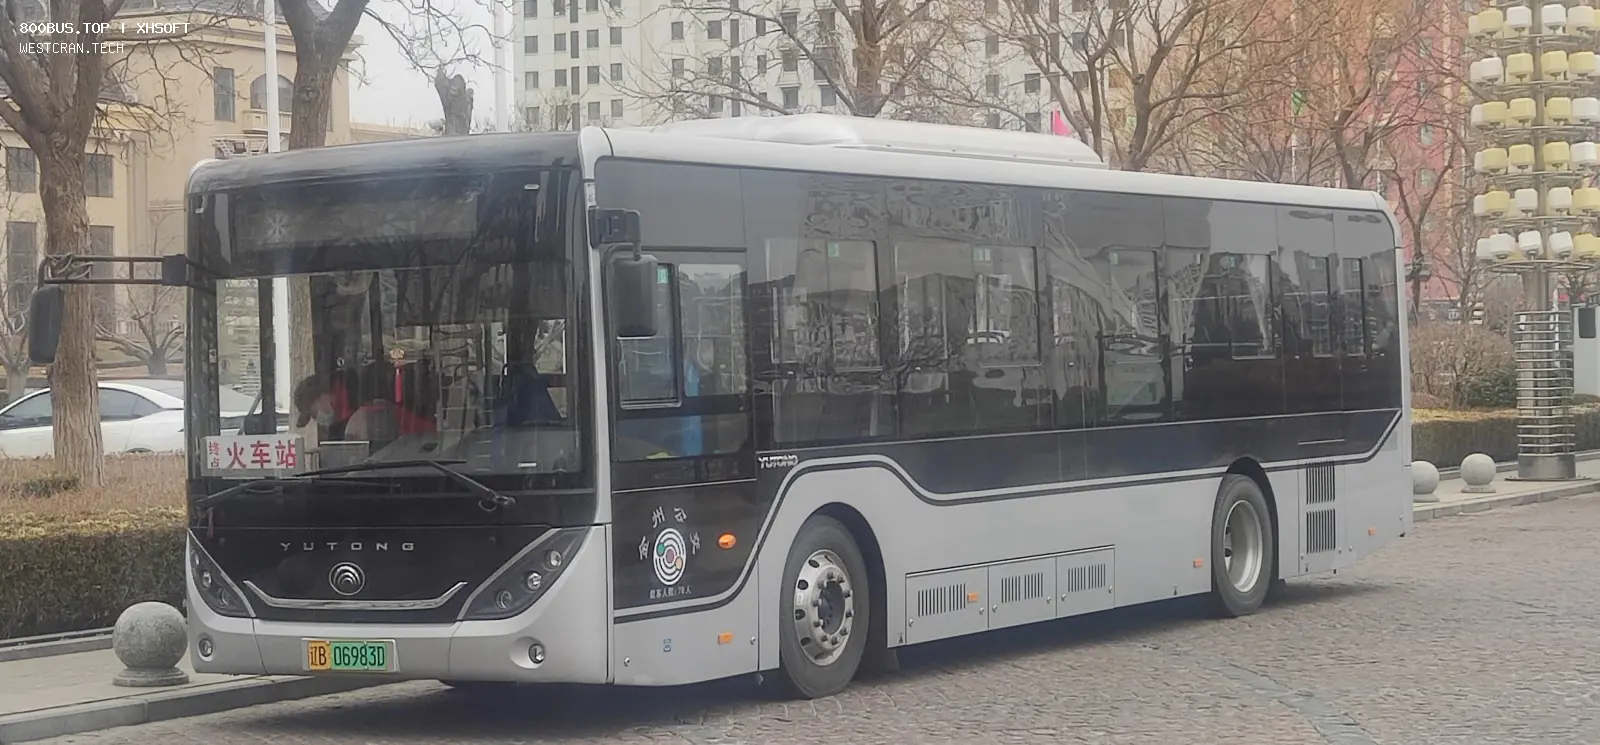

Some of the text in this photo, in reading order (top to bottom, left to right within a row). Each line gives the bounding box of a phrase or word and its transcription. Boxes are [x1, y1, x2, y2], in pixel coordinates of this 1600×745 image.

[227, 440, 297, 468] 火车站
[758, 455, 798, 469] YUTONG
[280, 542, 414, 551] YUTONG
